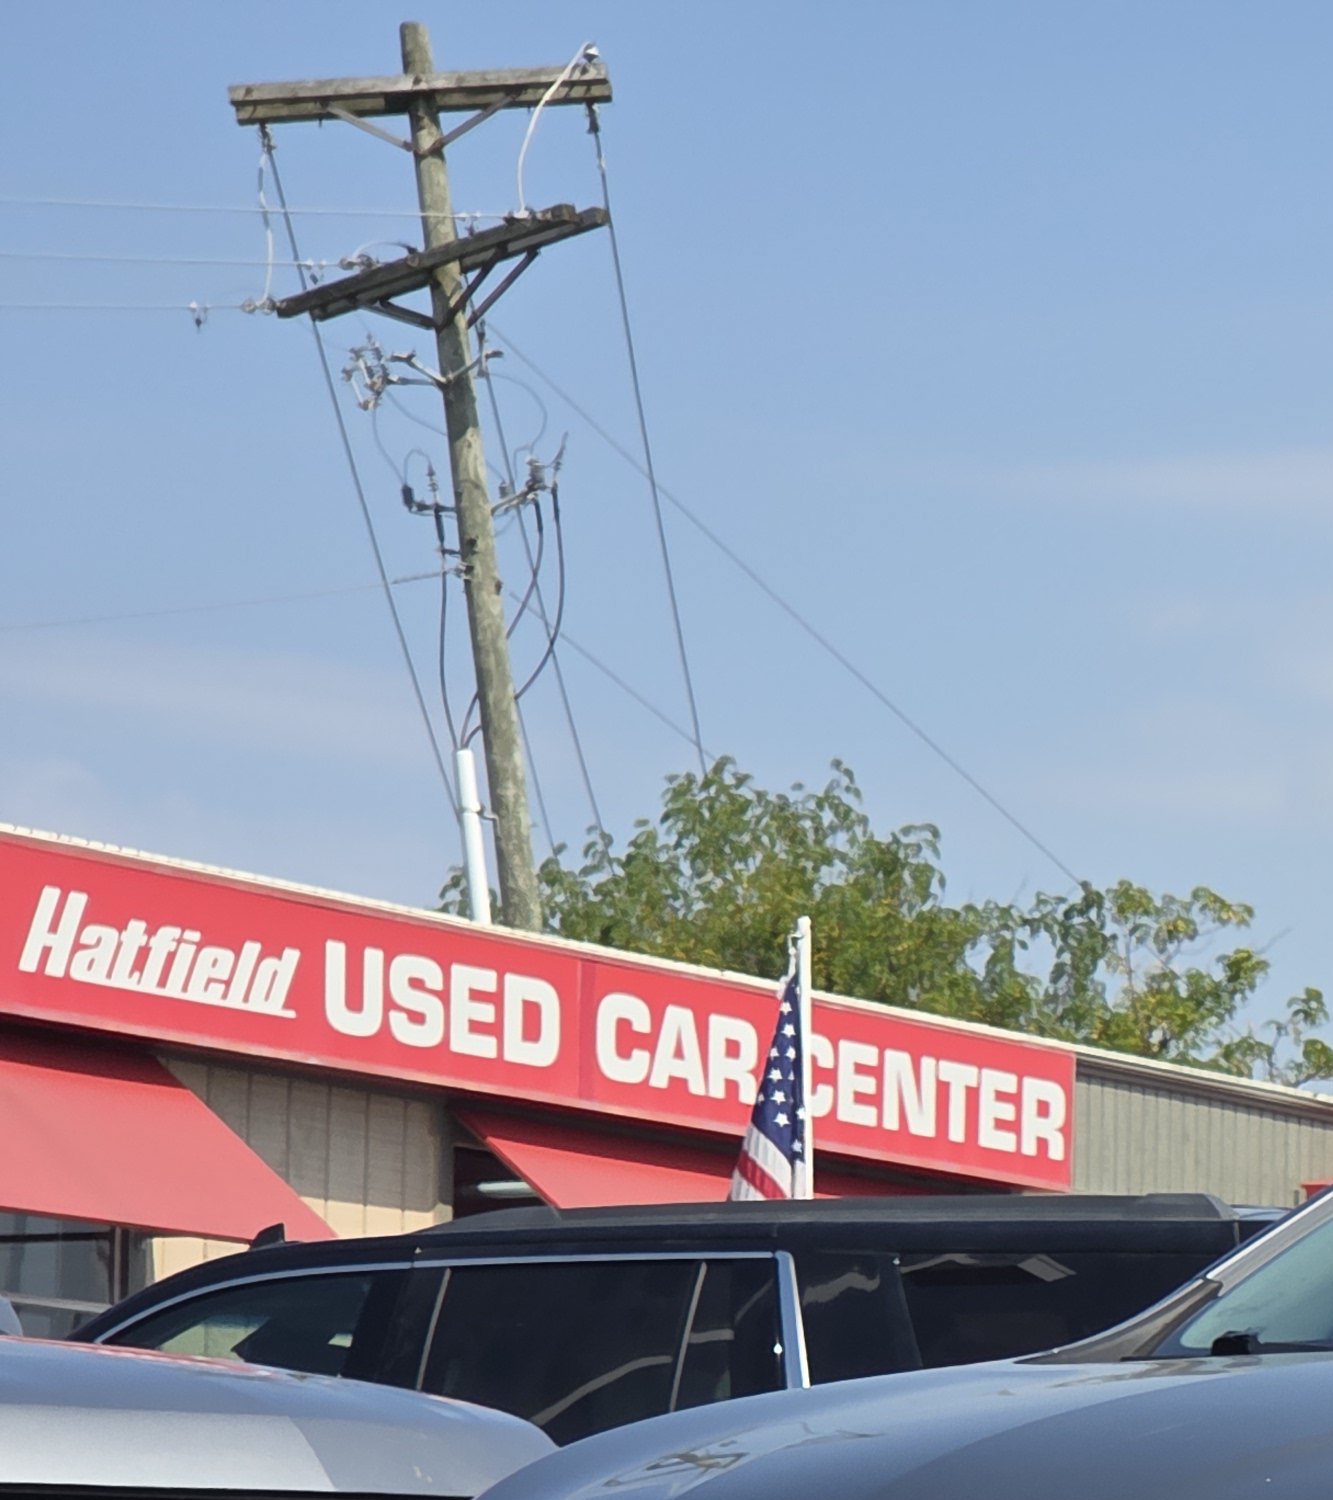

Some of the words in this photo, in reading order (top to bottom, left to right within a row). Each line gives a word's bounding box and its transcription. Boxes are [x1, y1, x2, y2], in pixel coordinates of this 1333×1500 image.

[18, 885, 300, 1018] Hatfield
[324, 939, 561, 1068] USED
[596, 991, 759, 1106] CAR
[808, 1034, 1067, 1161] CENTER
